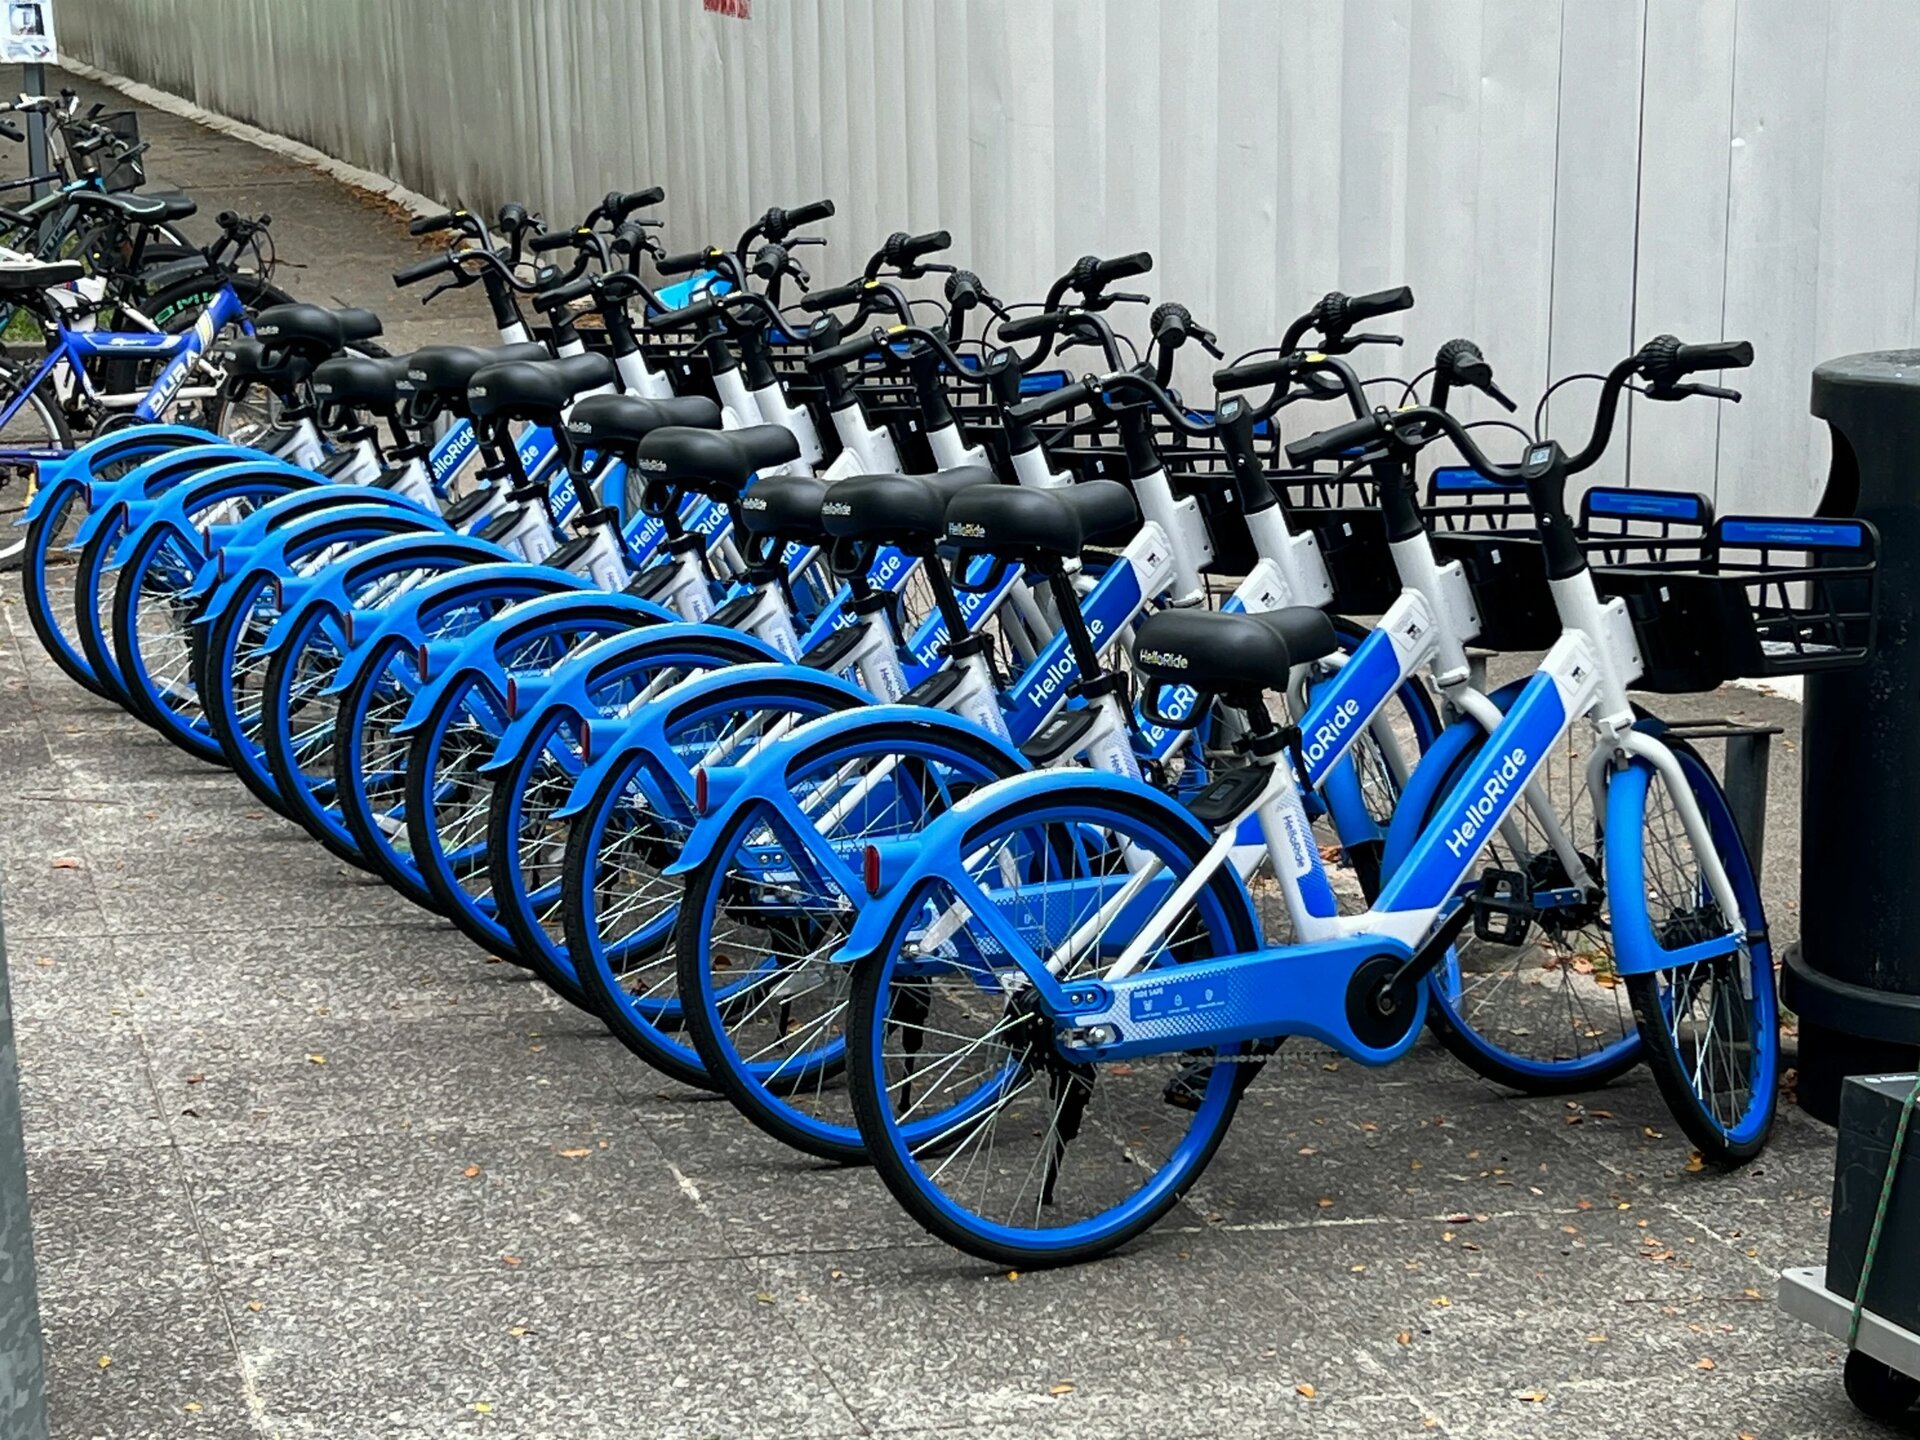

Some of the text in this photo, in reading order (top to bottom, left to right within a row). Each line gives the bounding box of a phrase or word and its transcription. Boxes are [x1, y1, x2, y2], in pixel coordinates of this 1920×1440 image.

[1140, 648, 1188, 669] HelloRide
[1444, 748, 1527, 858] HelloRide
[1283, 814, 1305, 868] HelloRide
